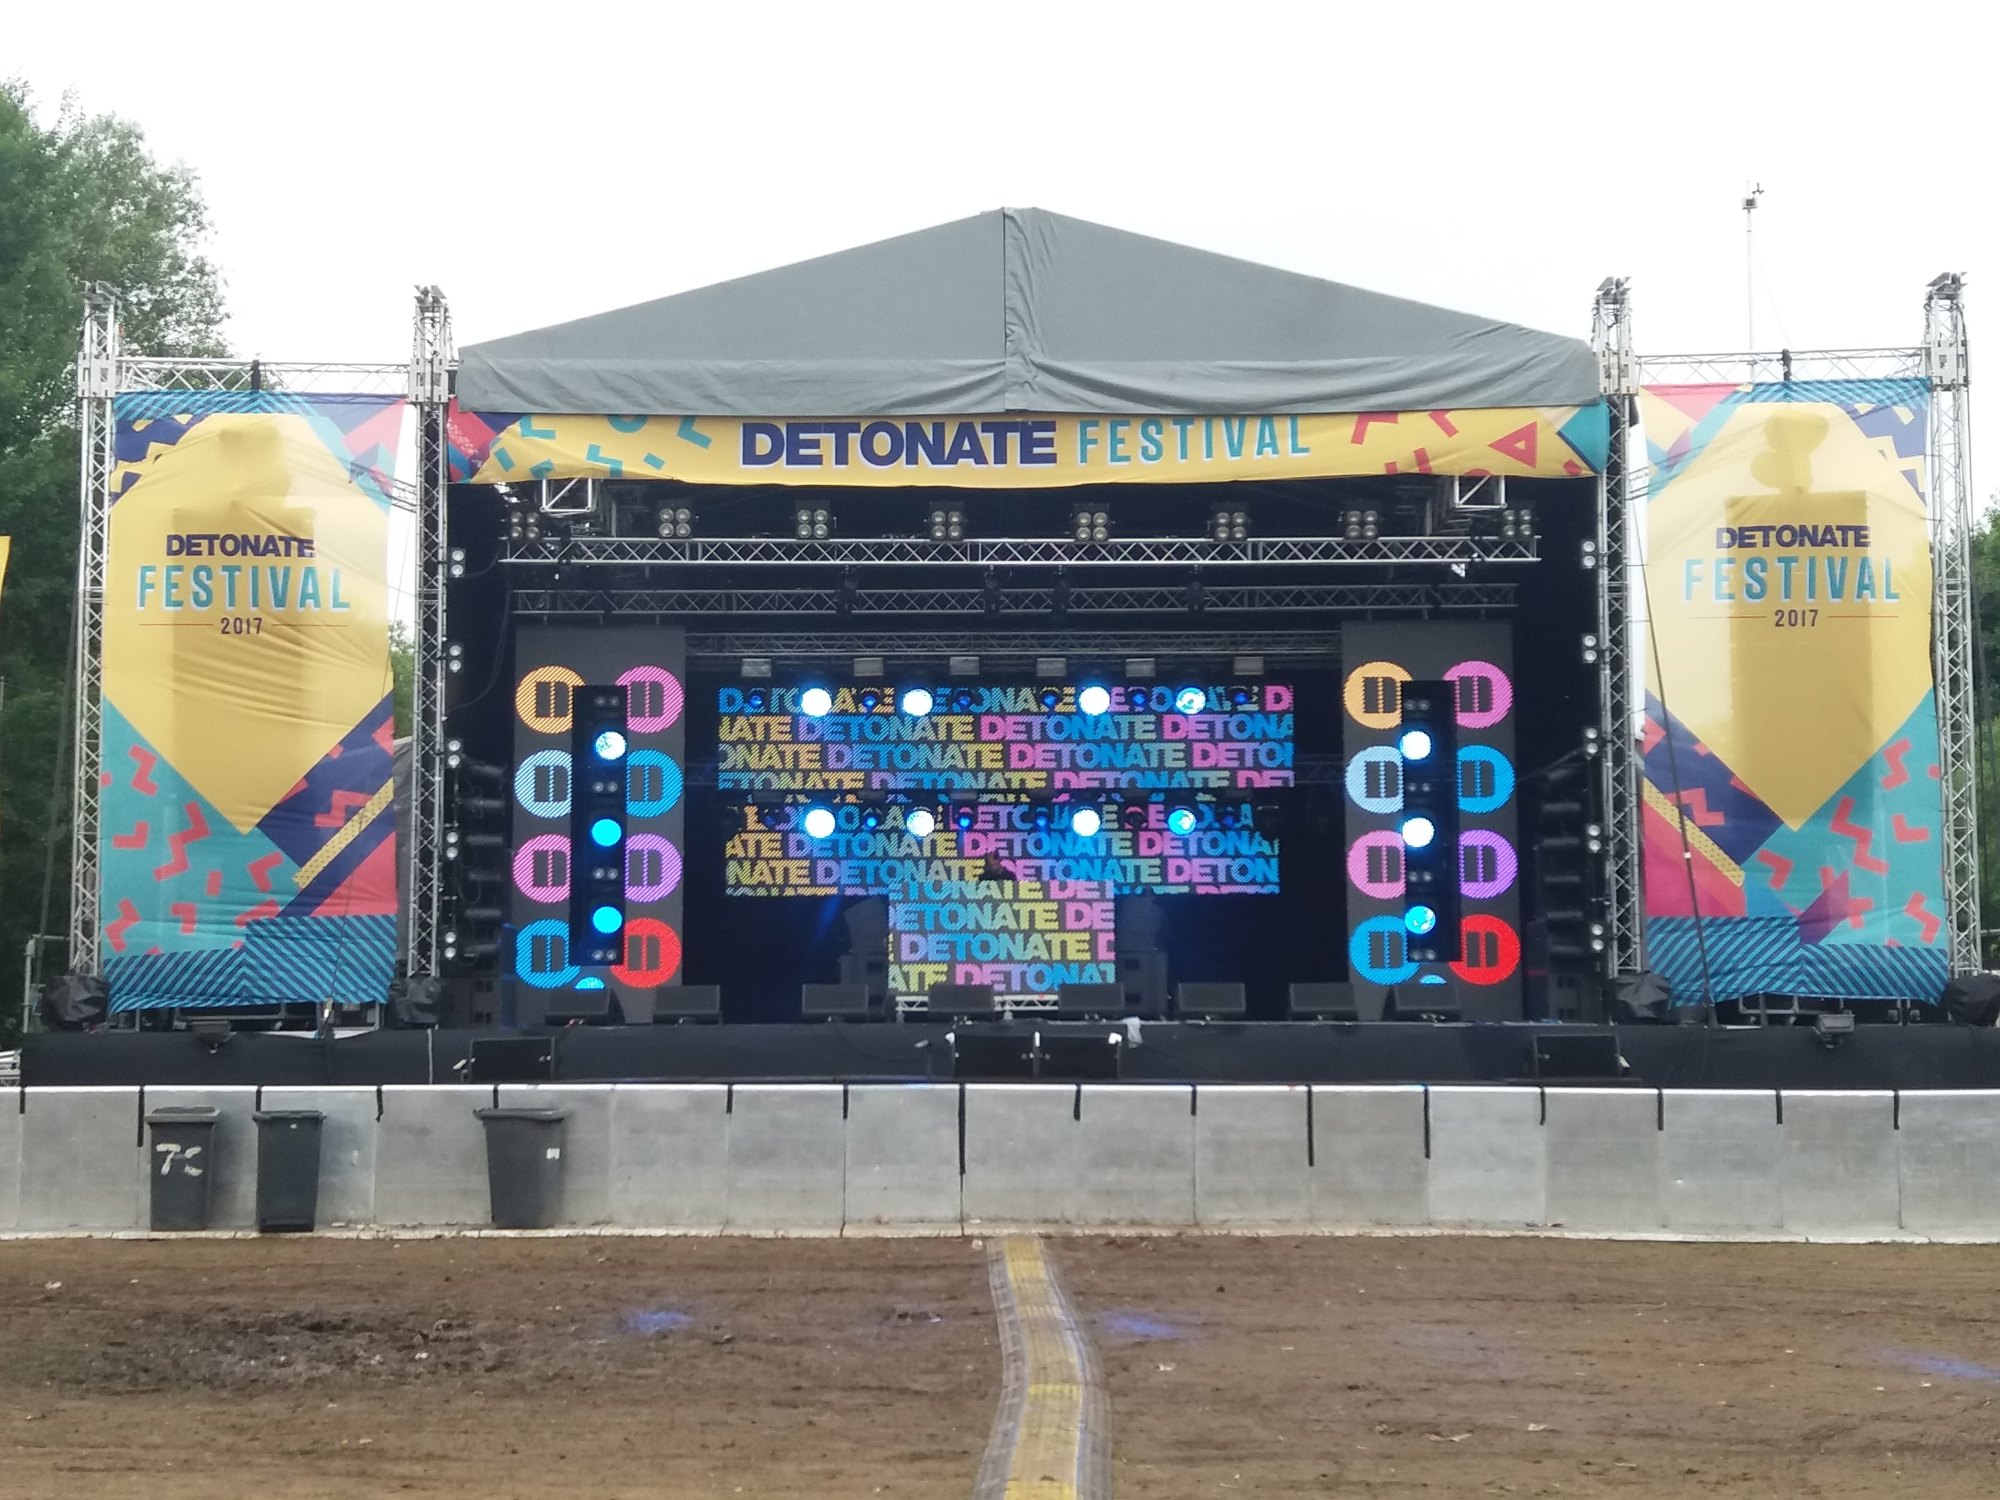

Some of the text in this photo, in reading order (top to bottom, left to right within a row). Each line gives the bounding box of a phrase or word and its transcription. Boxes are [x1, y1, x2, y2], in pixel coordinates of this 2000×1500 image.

[741, 415, 1312, 470] DETONATE FESTIVAL
[166, 533, 316, 558] DETONATE
[1716, 524, 1871, 549] DETONATE
[137, 565, 351, 611] FESTIVAL
[1683, 556, 1901, 603] FESTIVAL
[220, 617, 263, 635] 2017
[1774, 609, 1819, 627] 2017
[798, 715, 975, 742] DETONATE
[980, 714, 1157, 741] DETONATE
[827, 743, 1004, 770] DETONATE
[1009, 742, 1187, 769] DETONATE
[871, 771, 1048, 790] DETONATE
[1053, 770, 1231, 789] DETONATE
[963, 831, 1133, 857] DETONATE
[725, 857, 1280, 885] NATE DETONATE ETONATE DETON
[900, 932, 1092, 962] DETONATE
